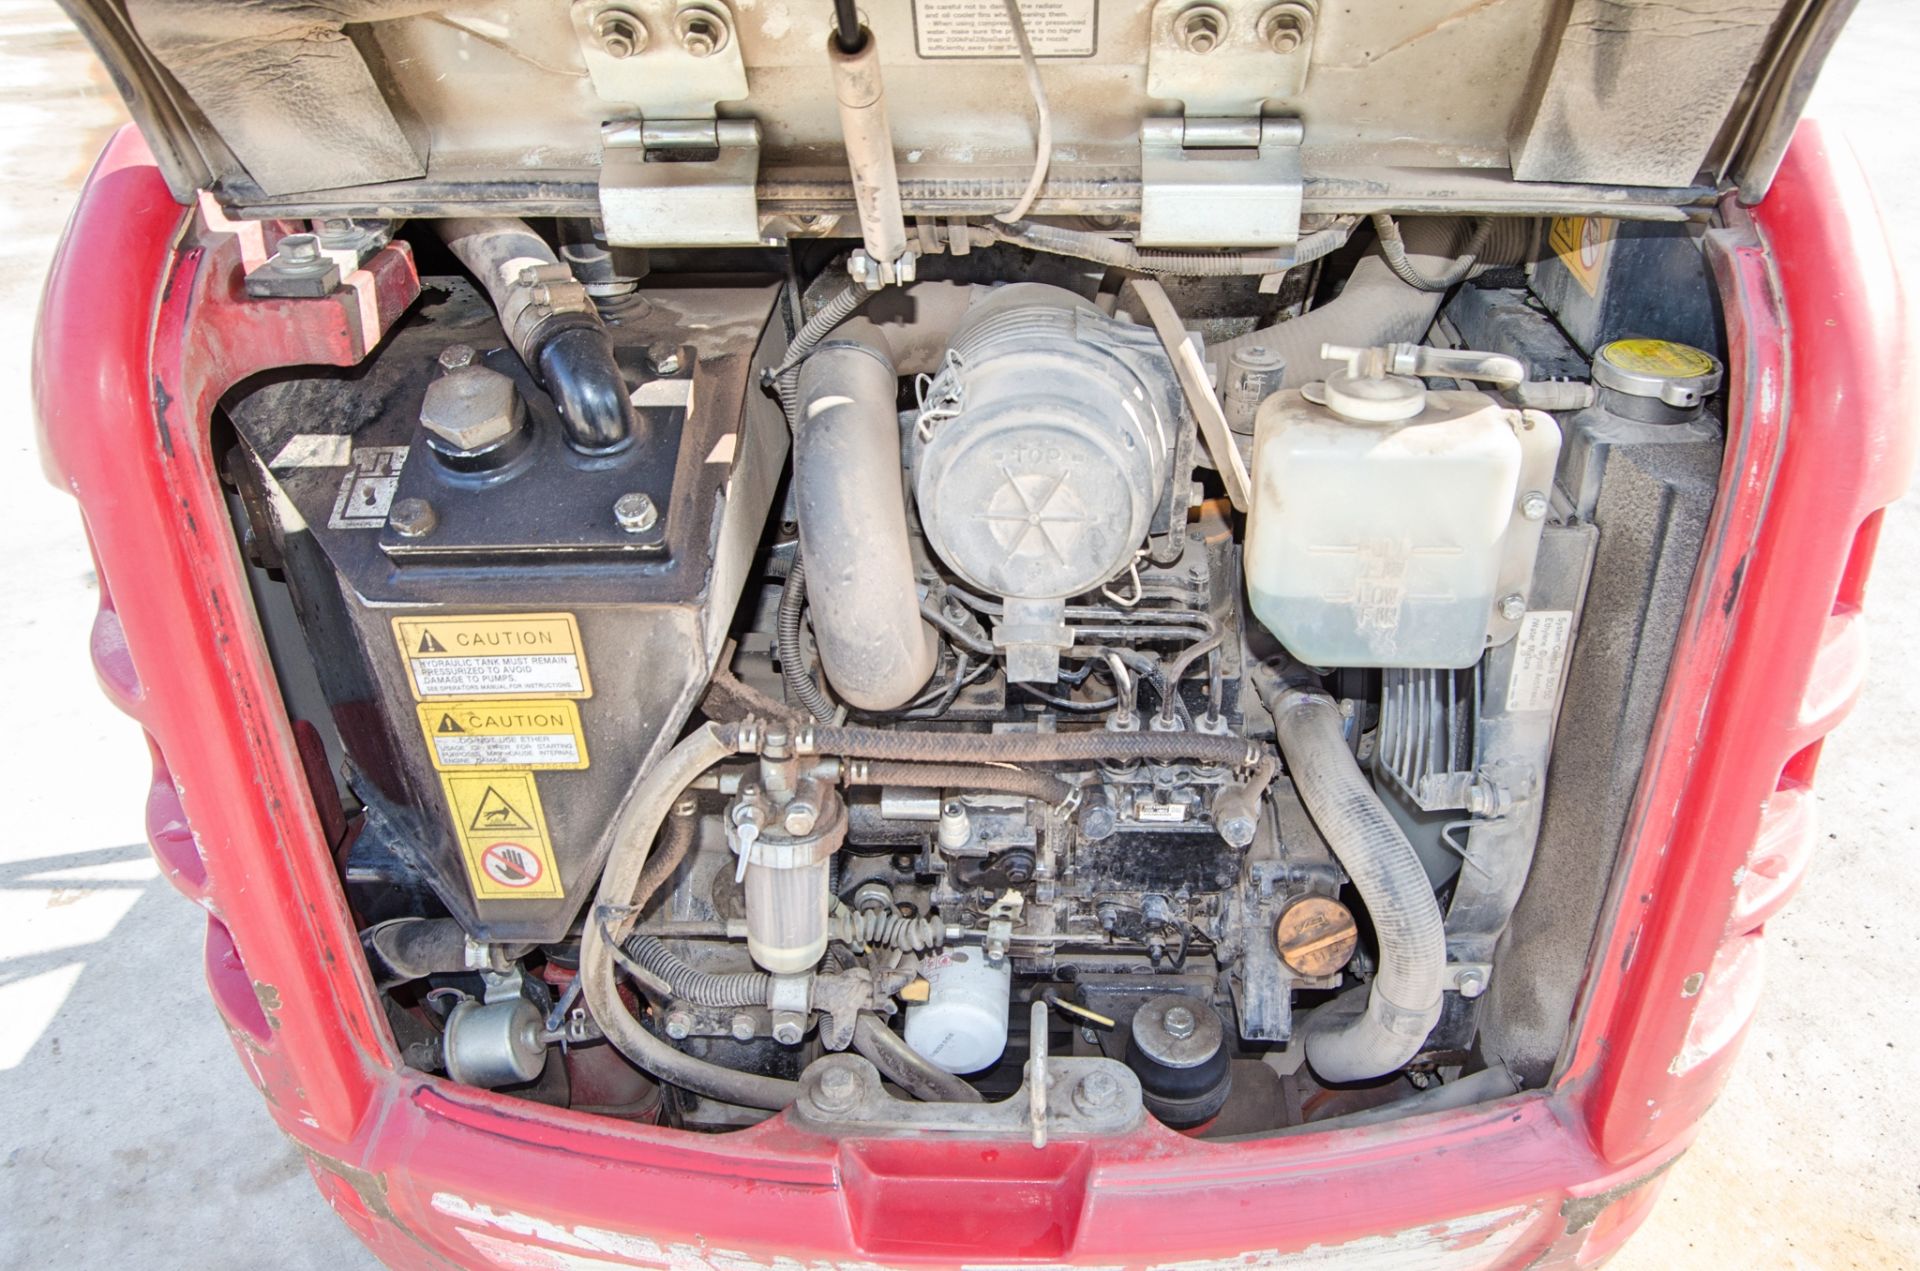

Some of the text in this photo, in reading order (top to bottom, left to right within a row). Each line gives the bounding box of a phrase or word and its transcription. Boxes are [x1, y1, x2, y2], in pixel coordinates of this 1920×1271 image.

[1013, 443, 1061, 464] TOP
[456, 631, 552, 647] CAUTION
[1541, 618, 1554, 646] Ethylene
[1555, 618, 1567, 642] System
[420, 659, 473, 668] HYDRAULIC
[475, 658, 498, 666] TANK
[1523, 644, 1536, 670] Mixture
[422, 667, 484, 676] PRESSURIZED
[424, 676, 464, 684] DAMAGE
[1544, 677, 1555, 700] 50/50
[468, 714, 564, 729] CAUTION
